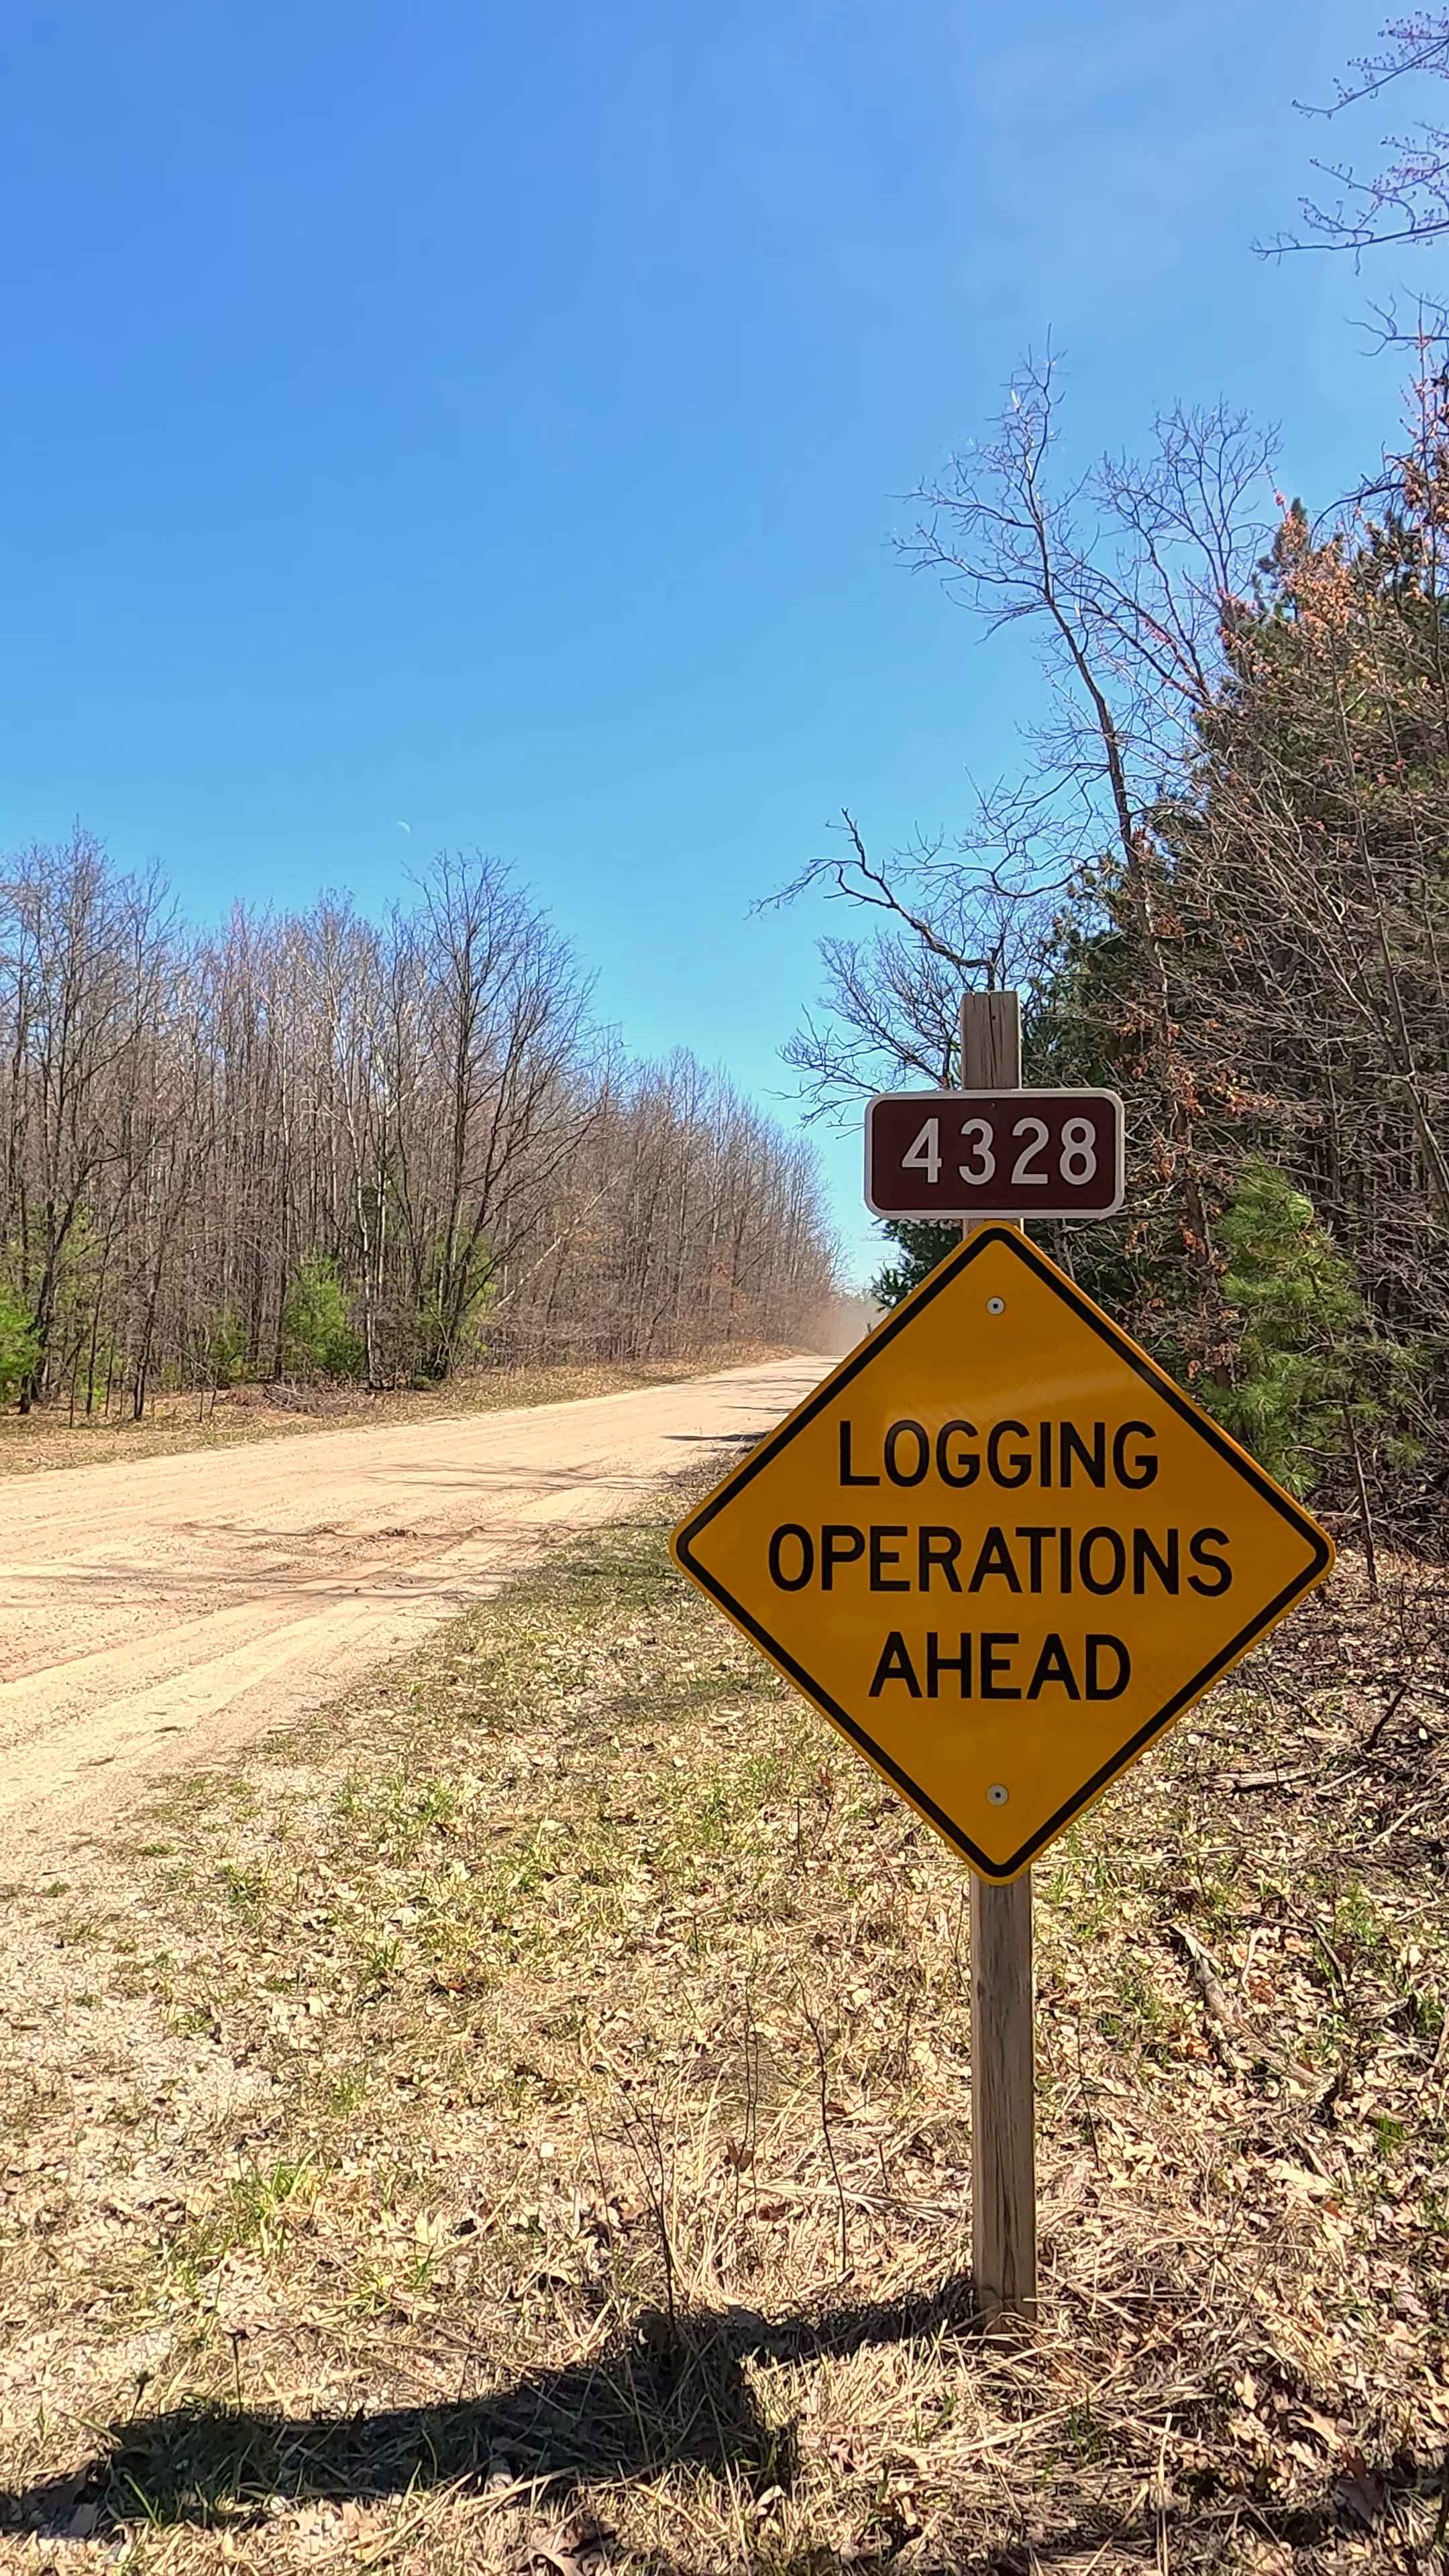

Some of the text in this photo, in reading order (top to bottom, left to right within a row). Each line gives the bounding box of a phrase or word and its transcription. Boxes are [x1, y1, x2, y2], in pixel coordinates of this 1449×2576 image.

[902, 1117, 1097, 1185] 4328
[840, 1419, 1159, 1490] LOGGING
[769, 1523, 1233, 1597] OPERATIONS
[868, 1631, 1131, 1701] AHEAD
